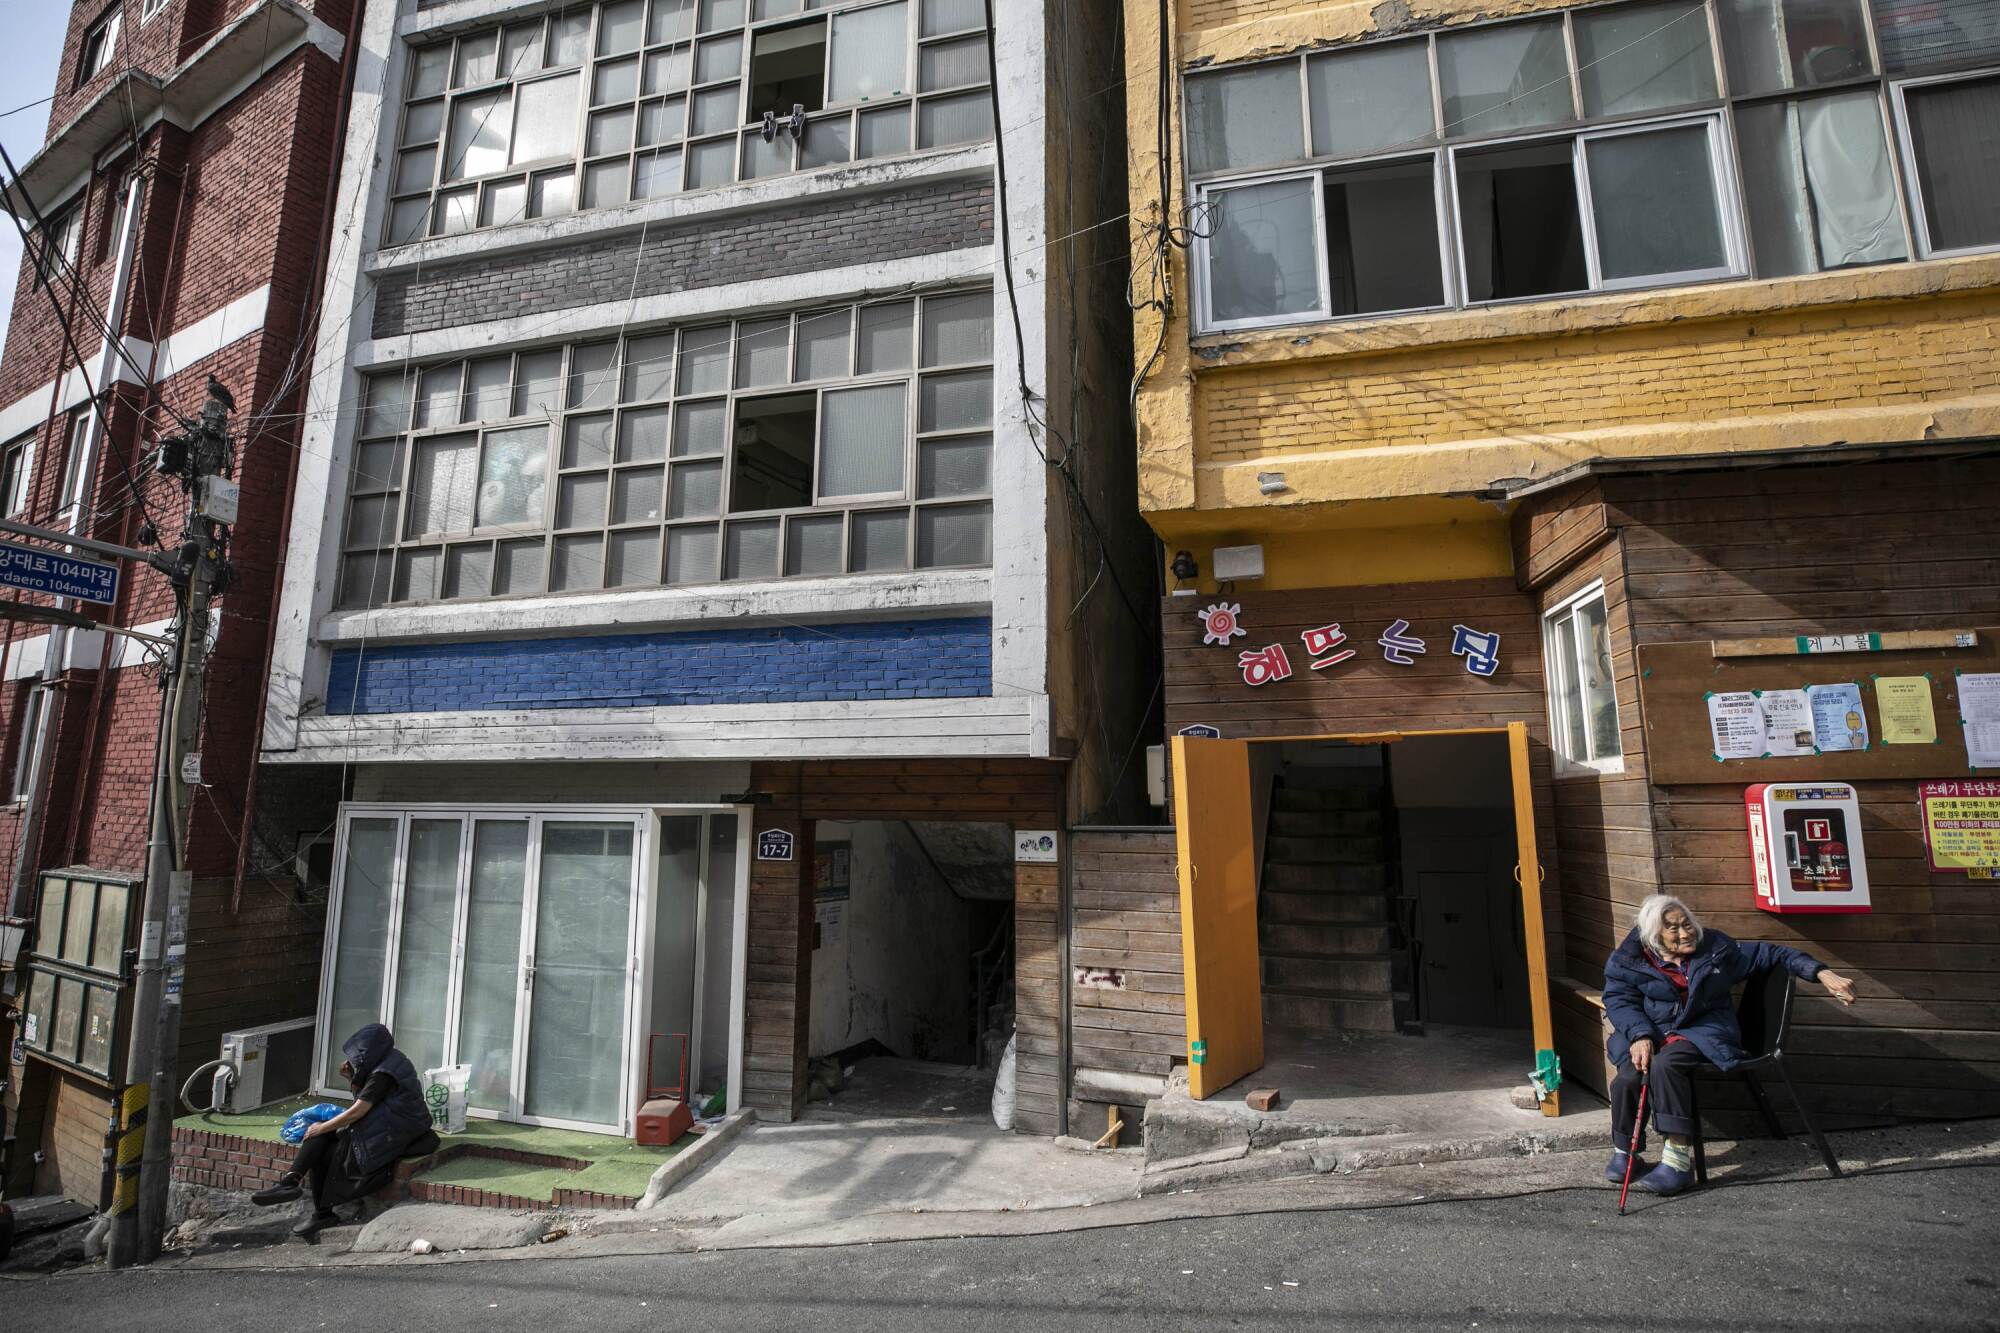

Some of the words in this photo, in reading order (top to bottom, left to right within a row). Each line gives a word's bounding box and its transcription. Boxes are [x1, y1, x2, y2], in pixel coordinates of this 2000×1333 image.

[49, 579, 111, 600] 104ma-gil
[1808, 634, 1869, 651] 게시물
[1926, 782, 1959, 796] 쓰레기
[762, 844, 789, 856] 17-7
[1803, 865, 1839, 876] 소화기
